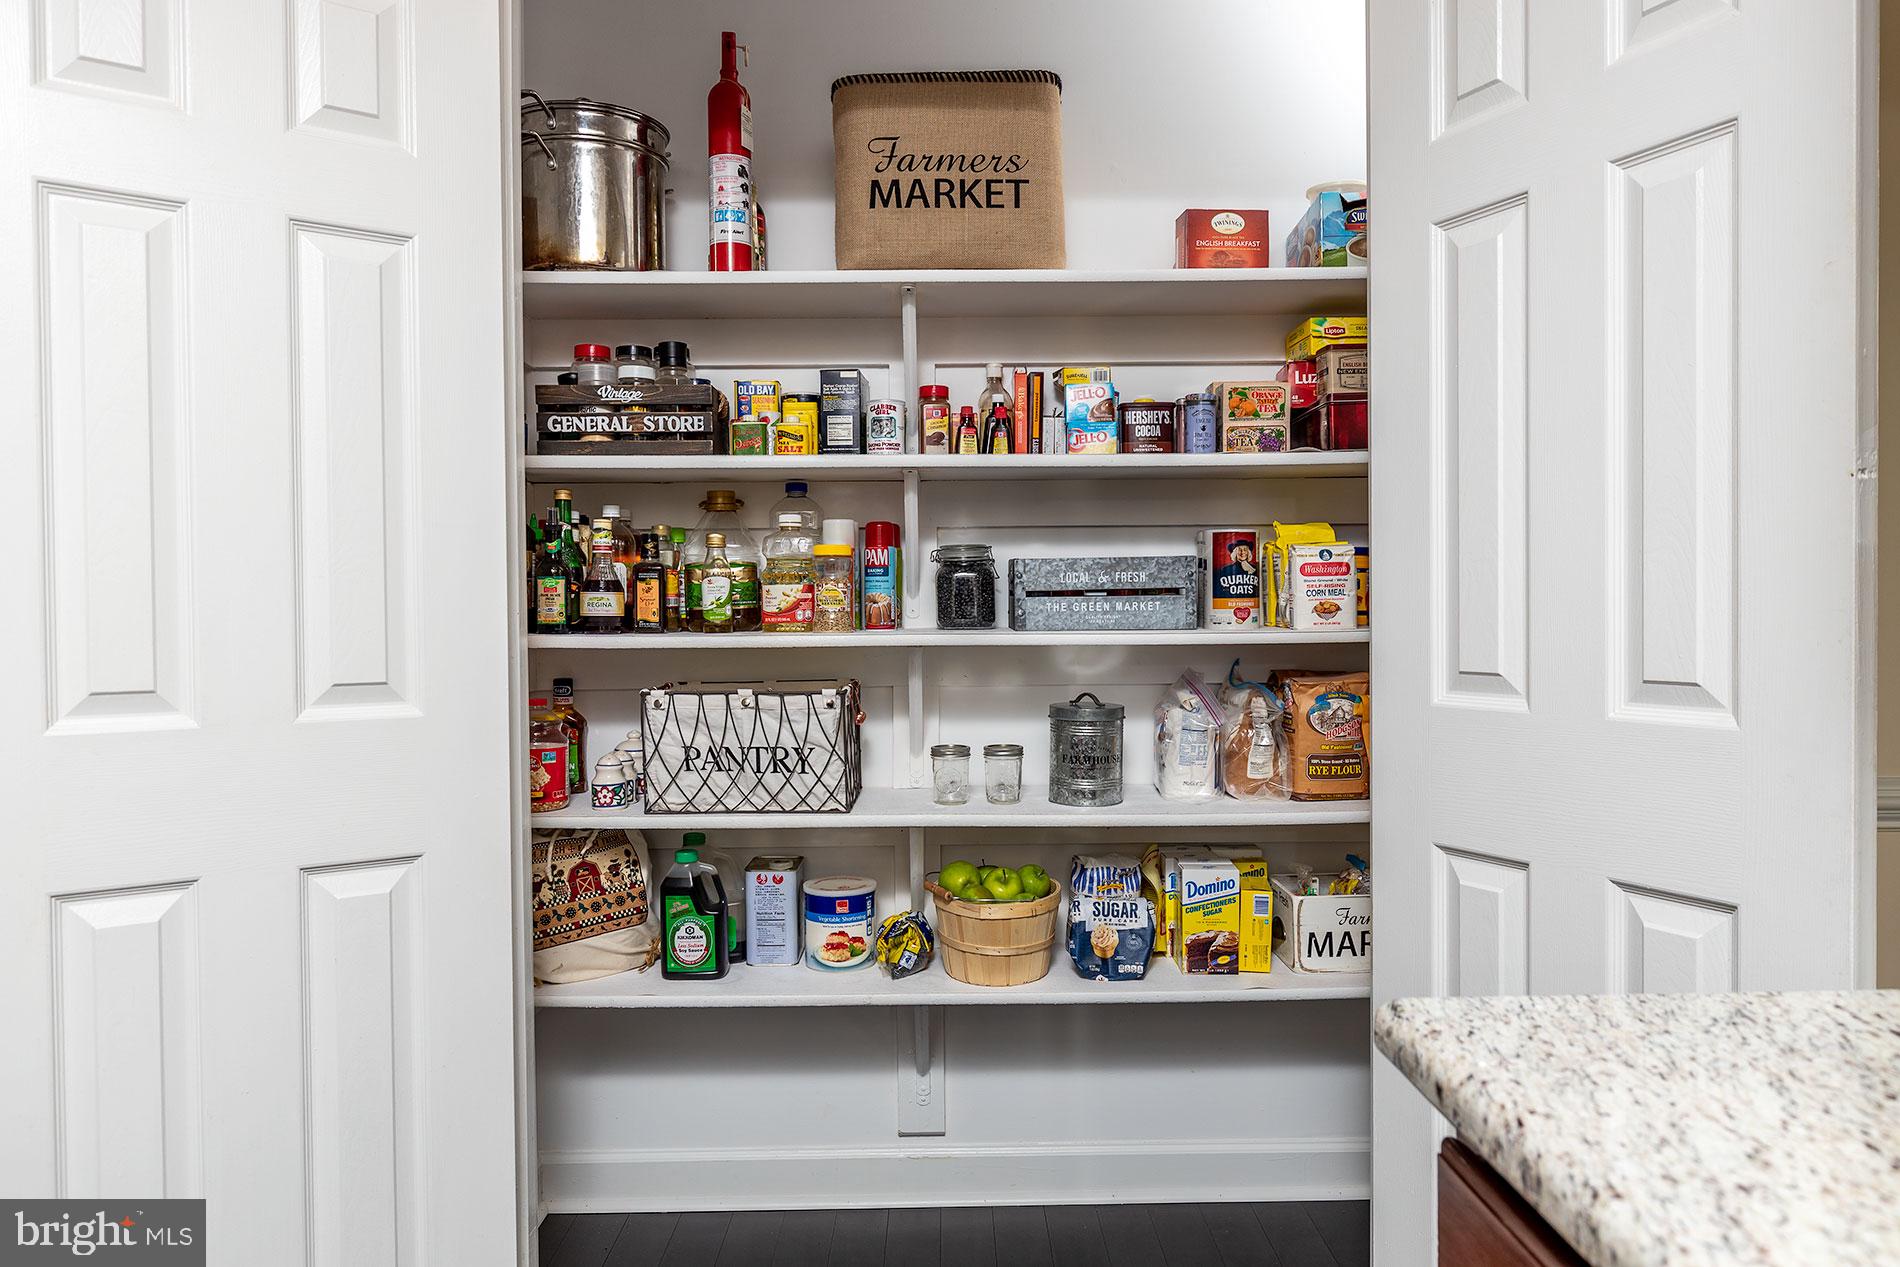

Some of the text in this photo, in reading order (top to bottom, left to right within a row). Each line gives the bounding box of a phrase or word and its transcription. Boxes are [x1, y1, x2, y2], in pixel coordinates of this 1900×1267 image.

[868, 136, 1029, 173] Farmers
[869, 178, 1029, 209] MARKET
[1214, 219, 1243, 227] TWININGS
[597, 386, 644, 403] Vintage
[738, 385, 774, 395] OLD BAY
[1251, 391, 1283, 399] ORANGE
[870, 404, 897, 412] CLABBER
[1257, 405, 1279, 413] TEA
[1125, 410, 1170, 425] HERSHEY'S
[547, 415, 704, 433] GENERAL STORE
[1135, 425, 1161, 437] COCOA
[1233, 438, 1254, 447] TEA
[865, 549, 888, 566] PAM
[1304, 564, 1348, 575] Washington
[1060, 570, 1146, 584] LOCAL & FRESH
[1220, 575, 1259, 587] QUAKER
[1230, 585, 1254, 595] OATS
[1306, 588, 1346, 597] CORN MEAL
[1046, 601, 1161, 612] THE GREEN MARKET
[1326, 717, 1361, 738] HODGSON
[681, 745, 815, 775] PANTRY
[1062, 753, 1121, 765] FARMHOUSE
[1309, 765, 1361, 775] RYE FLOUR
[1240, 868, 1265, 878] mino
[1185, 879, 1235, 898] Domino
[1092, 901, 1138, 918] SUGAR
[1185, 897, 1237, 914] CONFECTIONERS
[818, 914, 866, 923] Vegetable Shortening
[1202, 908, 1223, 917] SUGAR
